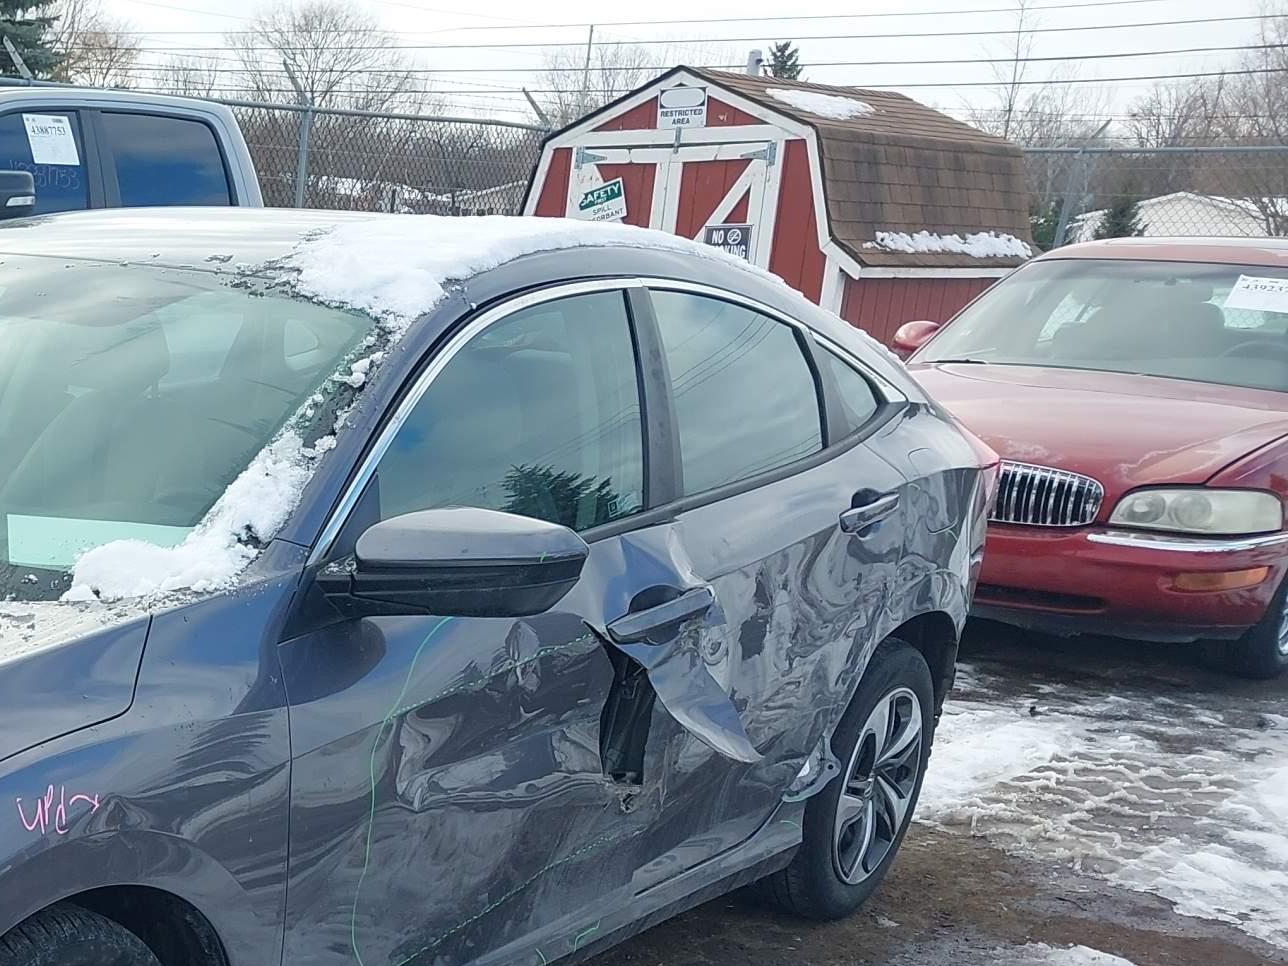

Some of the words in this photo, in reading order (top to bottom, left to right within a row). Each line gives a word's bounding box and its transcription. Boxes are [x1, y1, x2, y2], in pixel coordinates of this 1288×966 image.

[661, 109, 703, 117] RESTRICTED
[31, 125, 67, 136] 43887753
[592, 204, 612, 216] SPILL
[712, 230, 724, 244] NO
